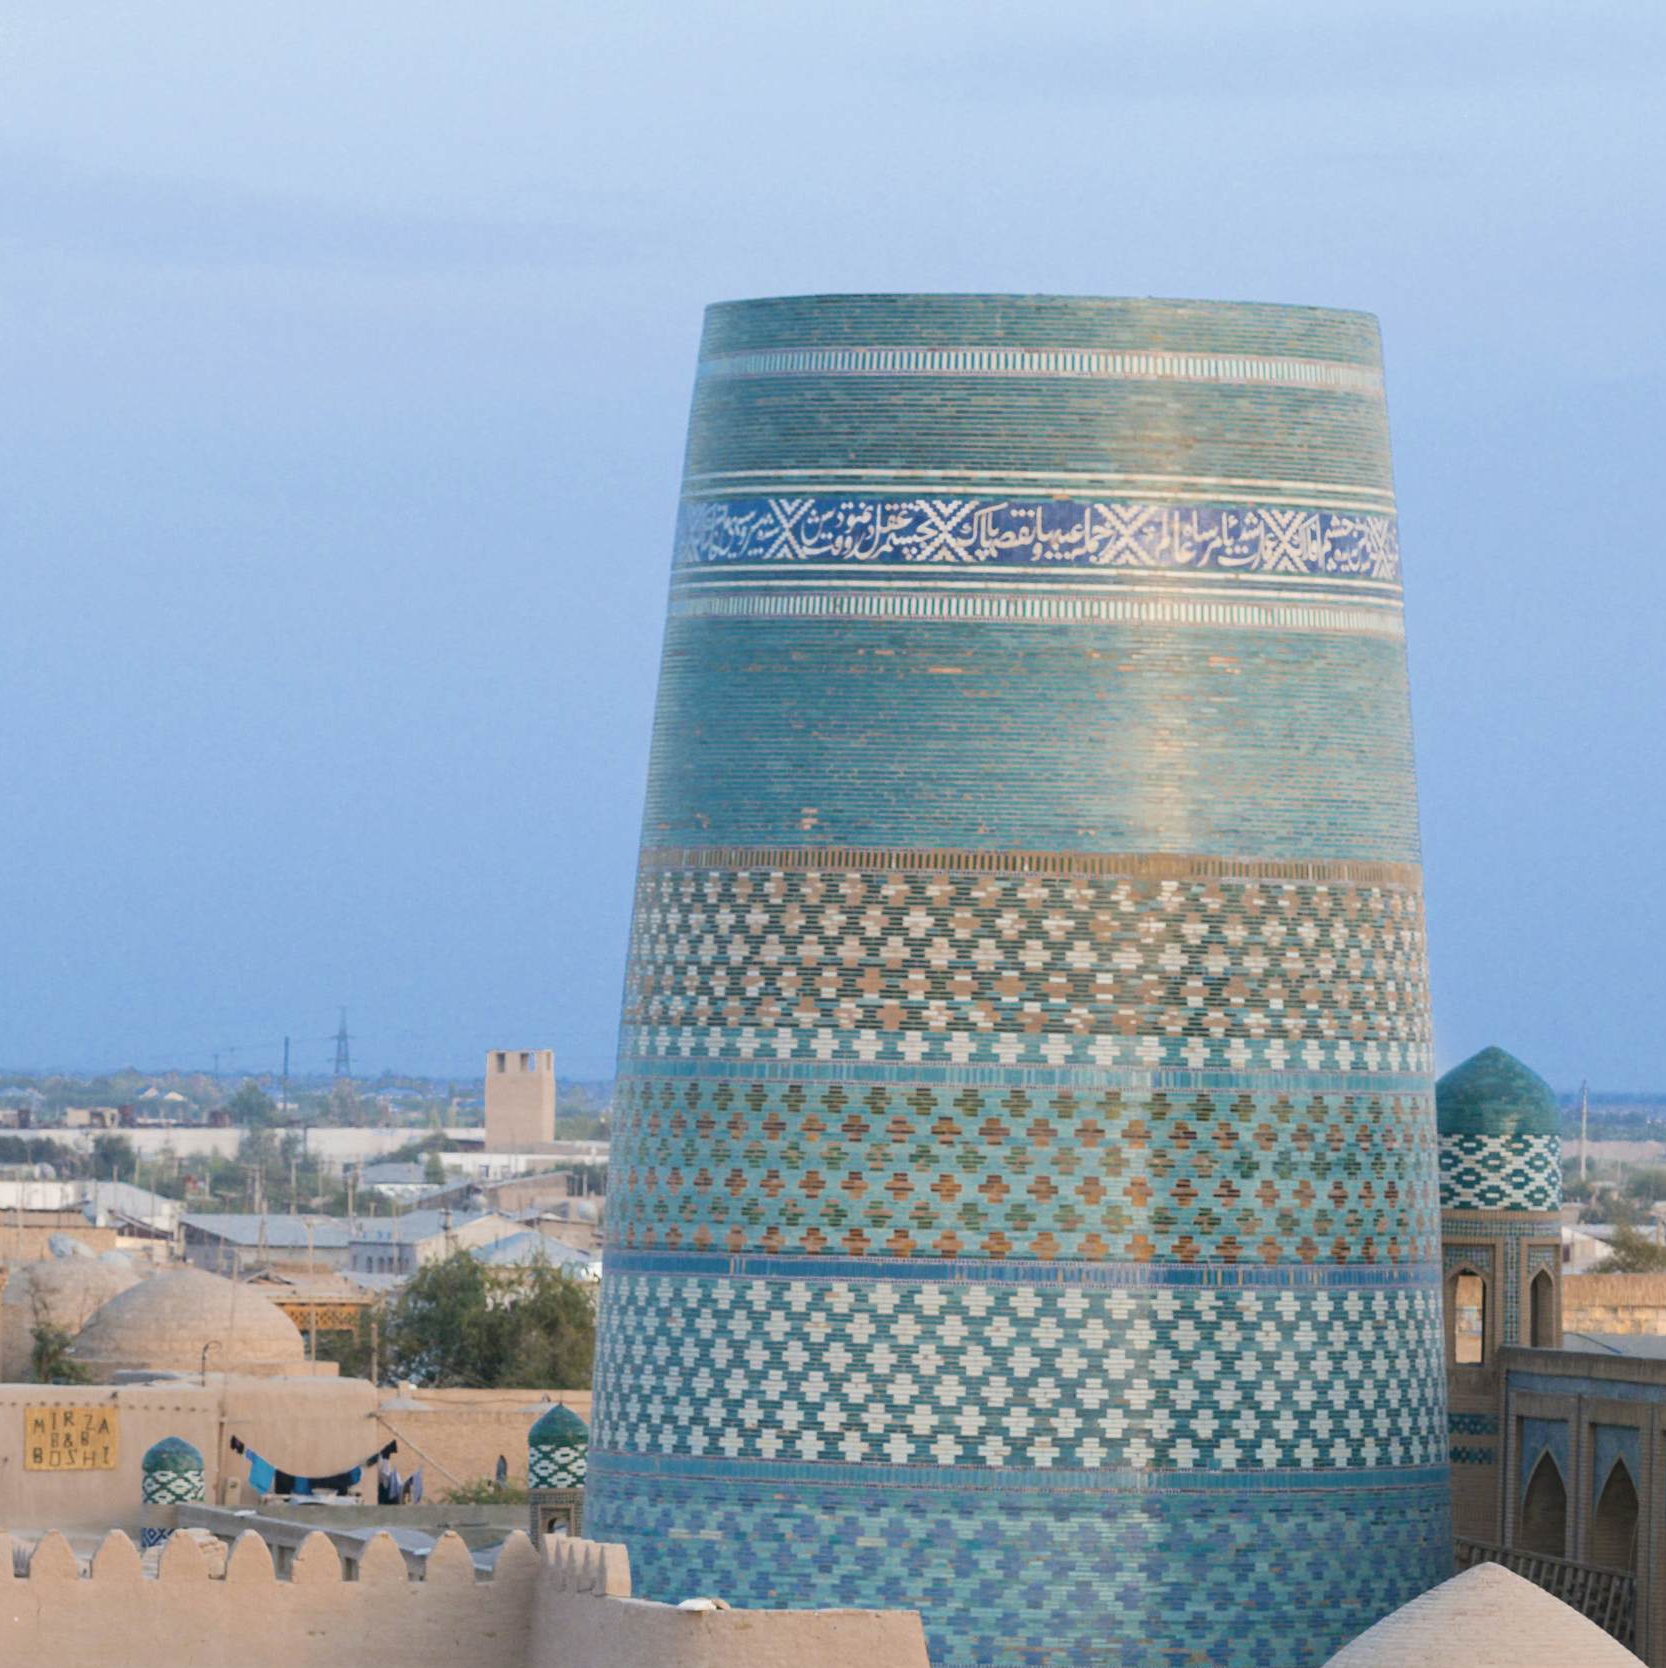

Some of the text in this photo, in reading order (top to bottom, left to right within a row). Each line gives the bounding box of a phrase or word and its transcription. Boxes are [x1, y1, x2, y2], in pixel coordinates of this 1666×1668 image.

[33, 1411, 110, 1434] MIRZA
[51, 1431, 90, 1448] B&B
[33, 1445, 110, 1467] BOSHI
